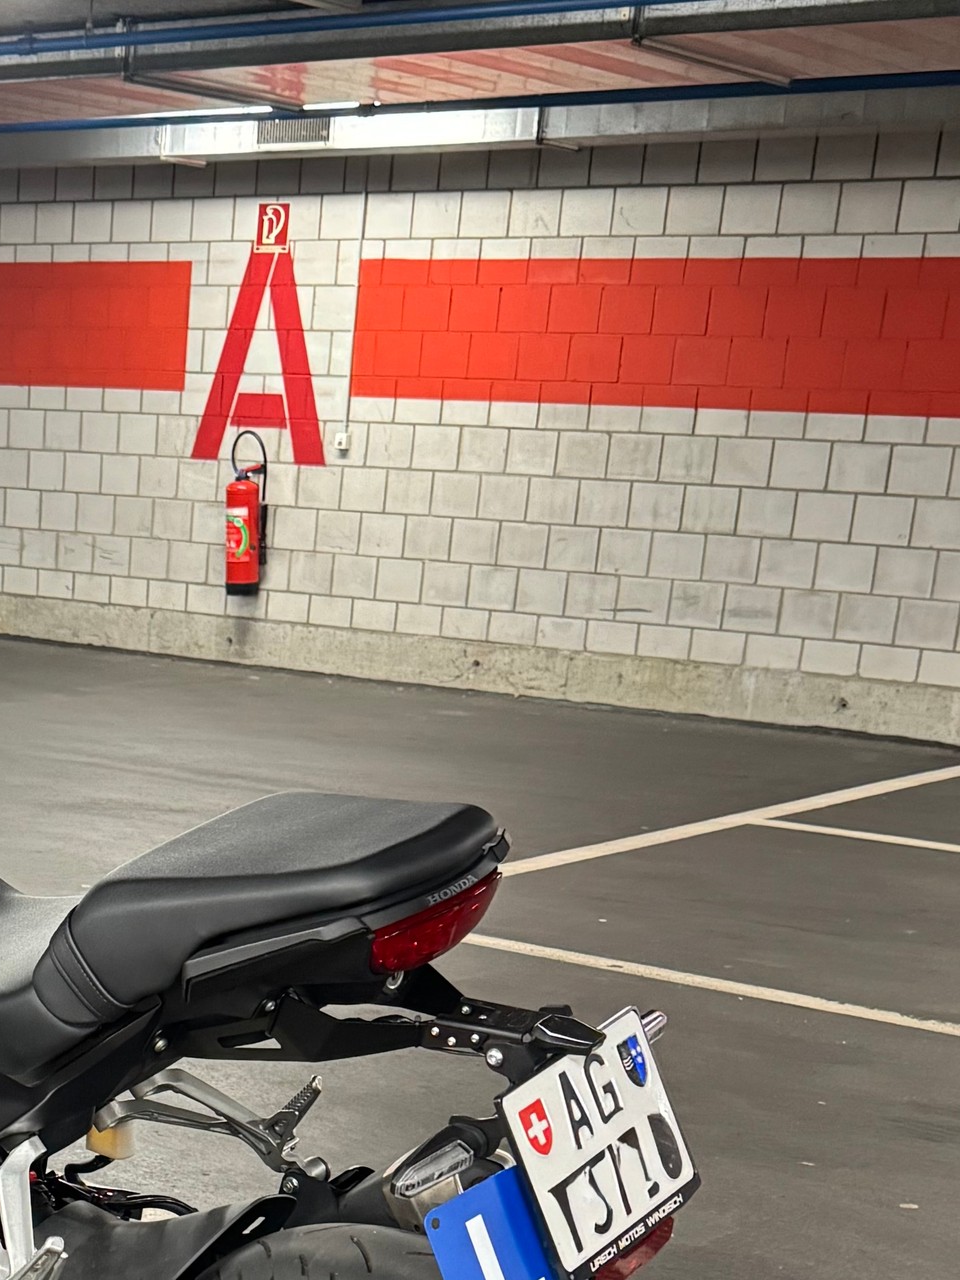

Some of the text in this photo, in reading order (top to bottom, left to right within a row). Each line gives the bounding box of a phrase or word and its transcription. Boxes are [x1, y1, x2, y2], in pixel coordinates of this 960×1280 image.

[190, 240, 326, 466] A
[427, 874, 479, 906] HONDA
[558, 1052, 625, 1151] AG
[590, 1192, 684, 1273] URECH MOTOS WINDISCH
